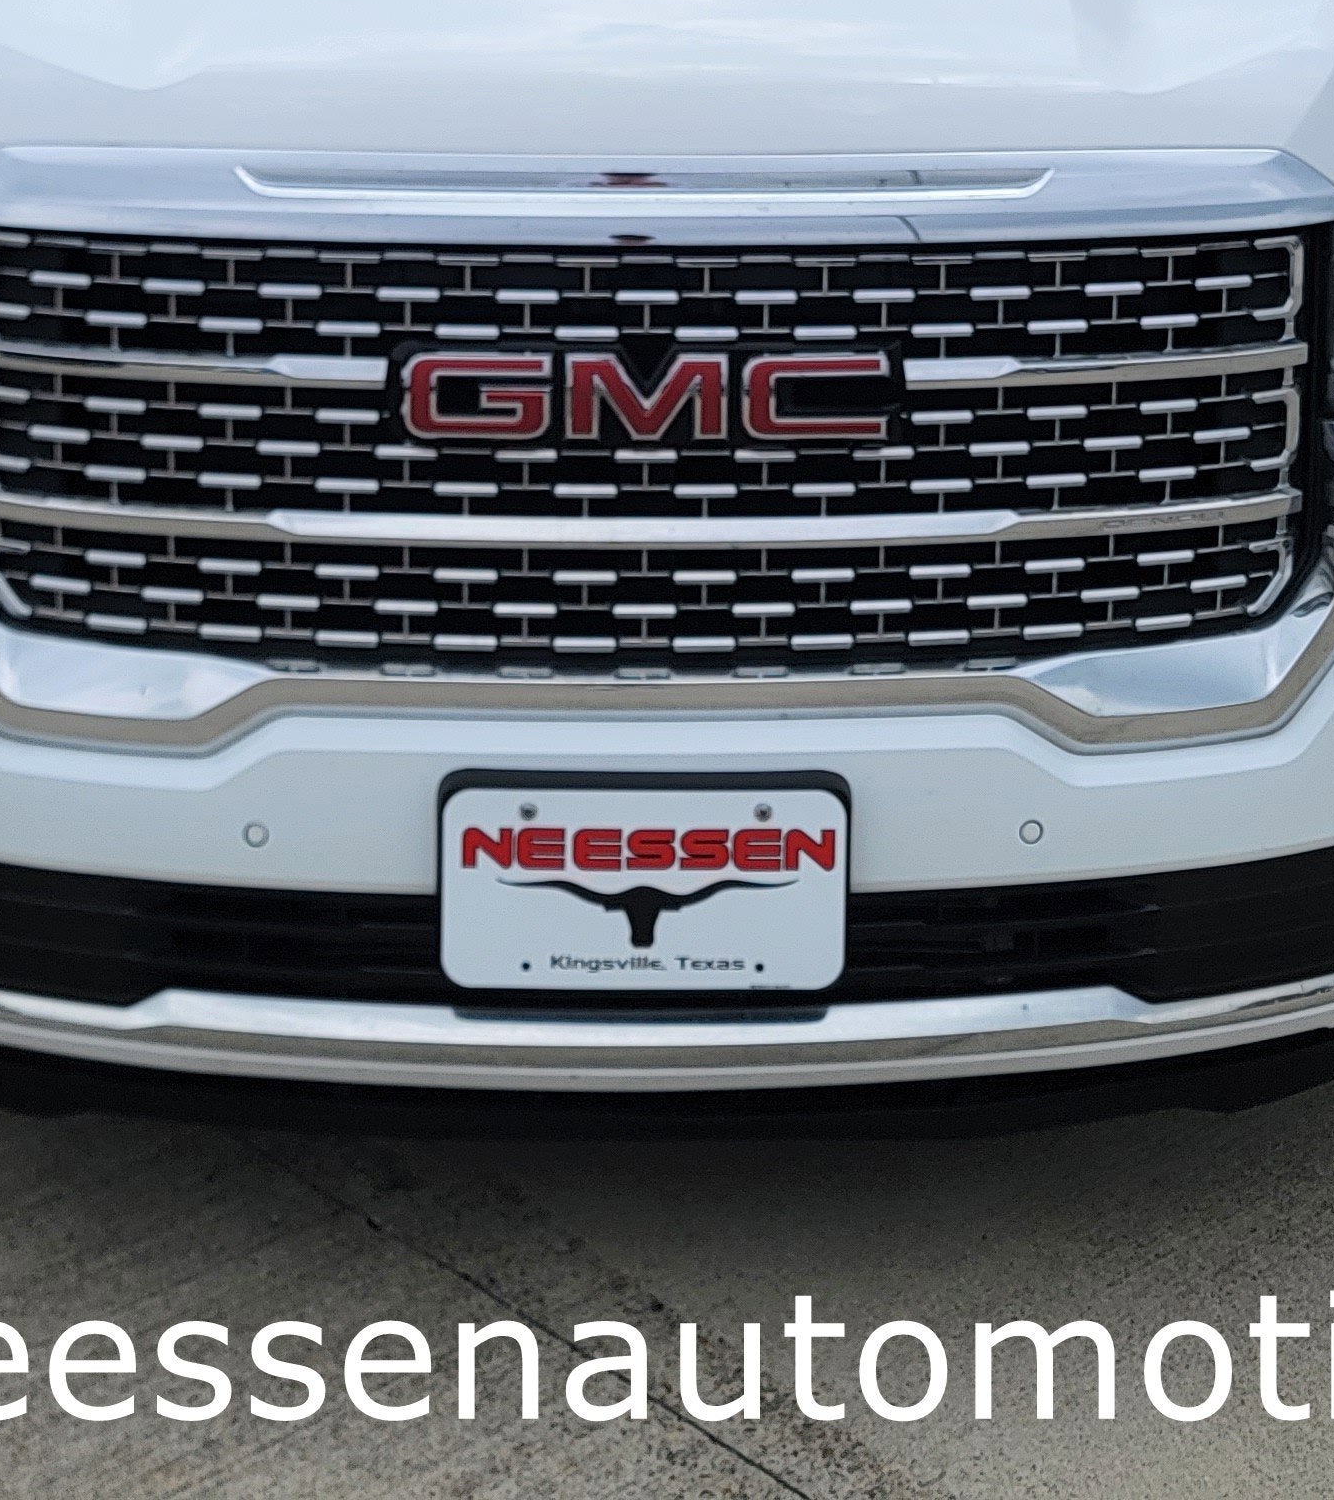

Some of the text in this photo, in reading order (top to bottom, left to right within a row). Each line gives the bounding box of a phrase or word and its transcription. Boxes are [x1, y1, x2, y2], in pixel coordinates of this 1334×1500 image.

[401, 352, 890, 440] GMC
[461, 827, 836, 872] NEESSEN
[677, 957, 746, 972] Texas
